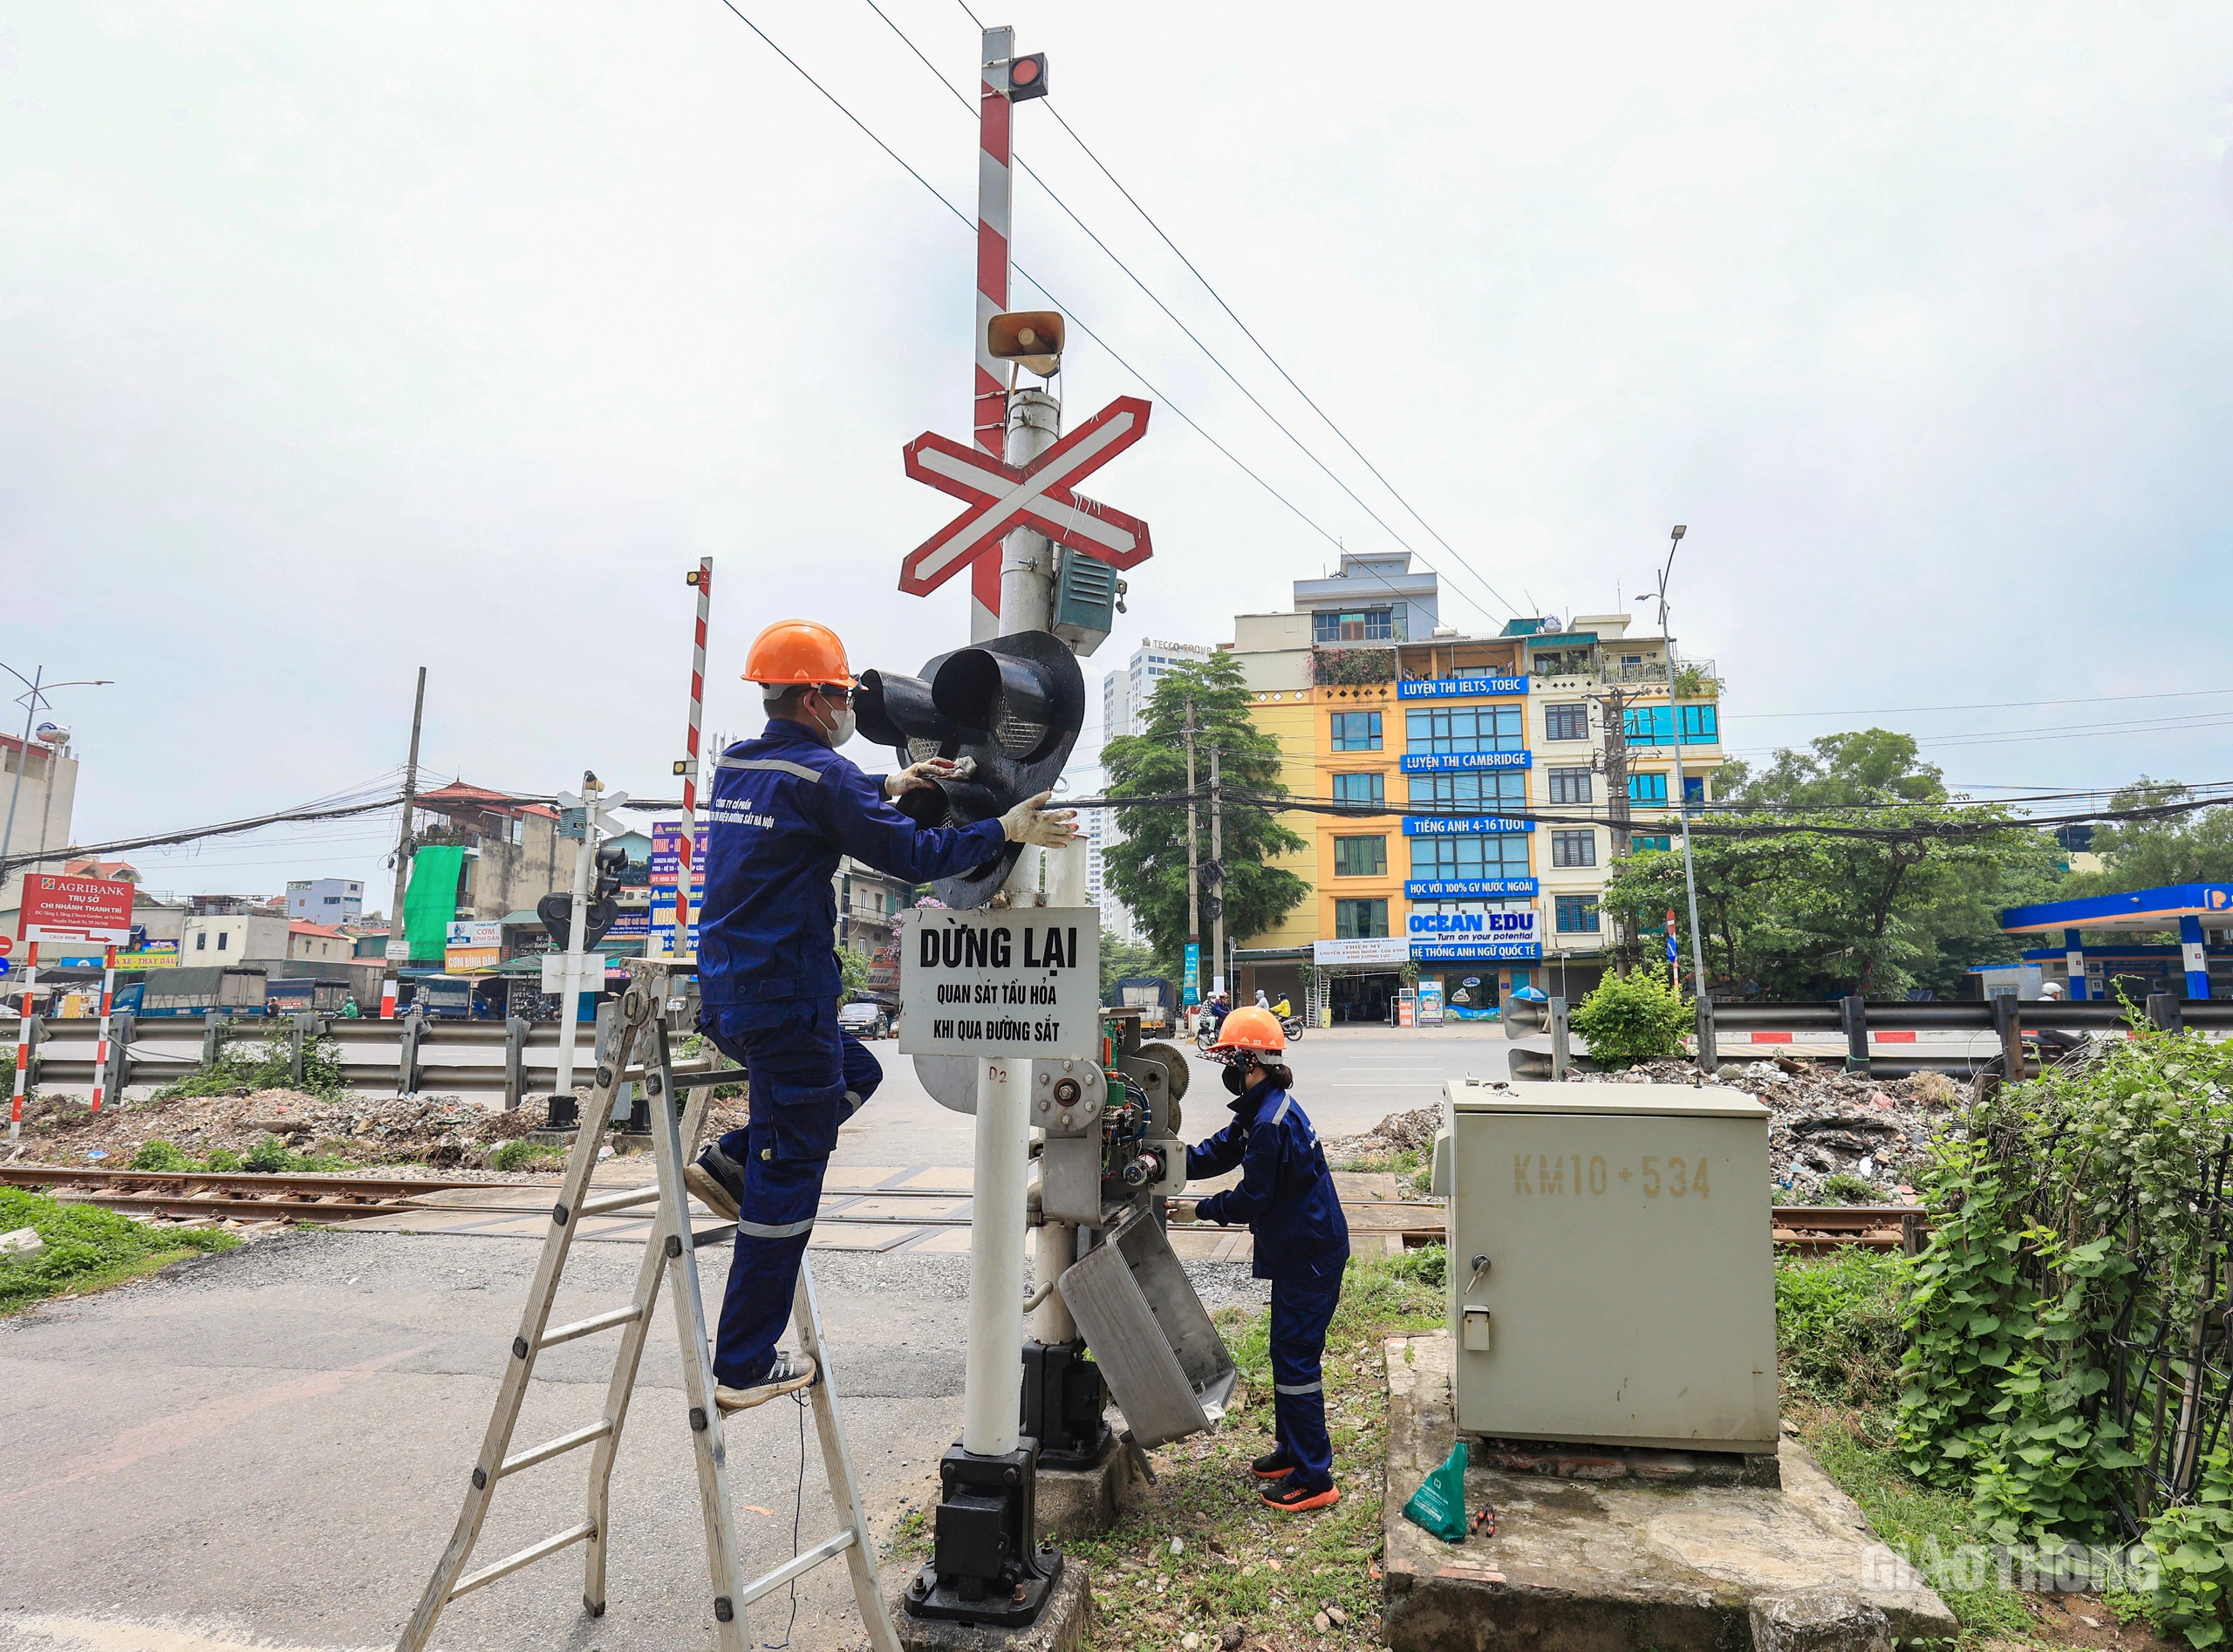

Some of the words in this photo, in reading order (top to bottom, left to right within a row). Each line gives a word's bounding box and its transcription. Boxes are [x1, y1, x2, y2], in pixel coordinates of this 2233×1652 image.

[1404, 681, 1436, 697] LUYỆN
[1439, 682, 1456, 693] THI
[1459, 680, 1490, 693] IELTS,
[1491, 679, 1520, 691] TOEIC
[1407, 754, 1439, 770] LUYỆN
[1443, 755, 1459, 767] THI
[1463, 753, 1526, 767] CAMBRIDGE
[1414, 816, 1444, 833] TIẾNG
[1447, 820, 1469, 832] ANH
[1472, 819, 1497, 831] 4-16
[652, 838, 669, 853] INOX
[58, 883, 125, 896] AGRIBANK
[1410, 884, 1426, 896] HỌC
[1429, 881, 1443, 893] VỚI
[1445, 883, 1467, 893] 100%
[1469, 883, 1480, 892] GV
[1482, 879, 1504, 892] NƯỚC
[1507, 880, 1533, 891] NGOÀI
[68, 895, 85, 904] TRỤ
[1410, 913, 1483, 932] OCEAN
[1489, 913, 1533, 931] EDU
[1472, 934, 1491, 943] your
[1493, 932, 1533, 941] potential
[920, 918, 1011, 968] DỪNG
[1024, 927, 1076, 976] LẠI
[1411, 946, 1423, 959] HỆ
[1425, 943, 1455, 957] THỐNG
[1457, 947, 1475, 957] ANH
[1478, 945, 1497, 956] NGỮ
[1499, 943, 1524, 956] QUỐC
[1526, 943, 1536, 955] TẾ
[448, 956, 463, 967] CƠM
[937, 984, 971, 1004] QUAN
[974, 979, 998, 1004] SÁT
[1002, 978, 1026, 1004] TẦU
[1030, 977, 1057, 1005] HỎA
[933, 1020, 953, 1039] KHI
[958, 1020, 982, 1041] QUA
[986, 1015, 1030, 1041] ĐƯỜNG
[1035, 1014, 1060, 1041] SẮT
